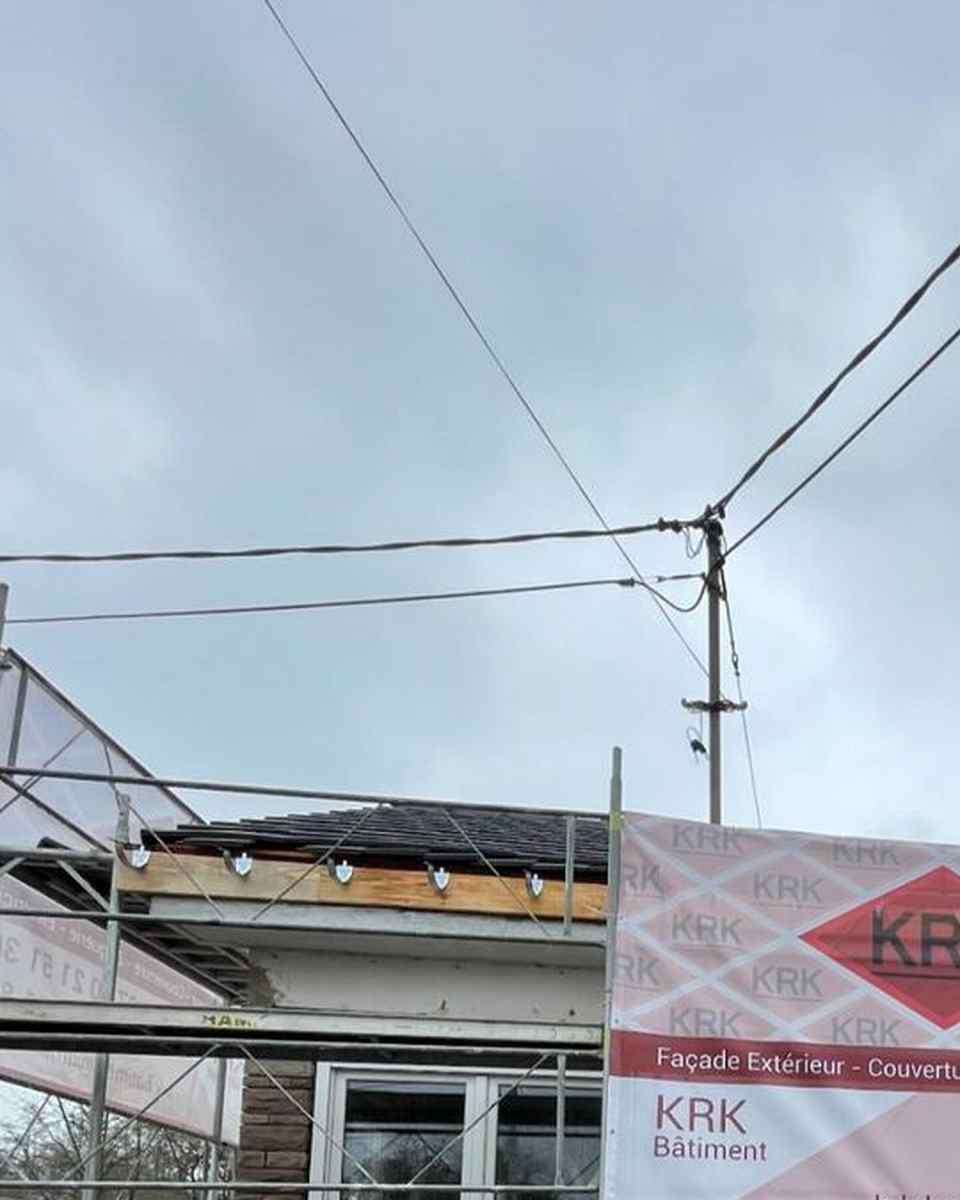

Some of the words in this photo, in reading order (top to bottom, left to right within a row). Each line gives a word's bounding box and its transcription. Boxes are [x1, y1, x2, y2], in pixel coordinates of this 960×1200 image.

[672, 825, 742, 852] KRK
[753, 872, 823, 901] KRK
[671, 912, 741, 943] KRK
[751, 963, 823, 995] KRK
[669, 1006, 740, 1036] KRK
[832, 1016, 900, 1045] KRK
[656, 1047, 741, 1072] Façade
[747, 1052, 845, 1075] Extérieur
[656, 1094, 747, 1135] KRK
[653, 1136, 767, 1162] Bâtiment
